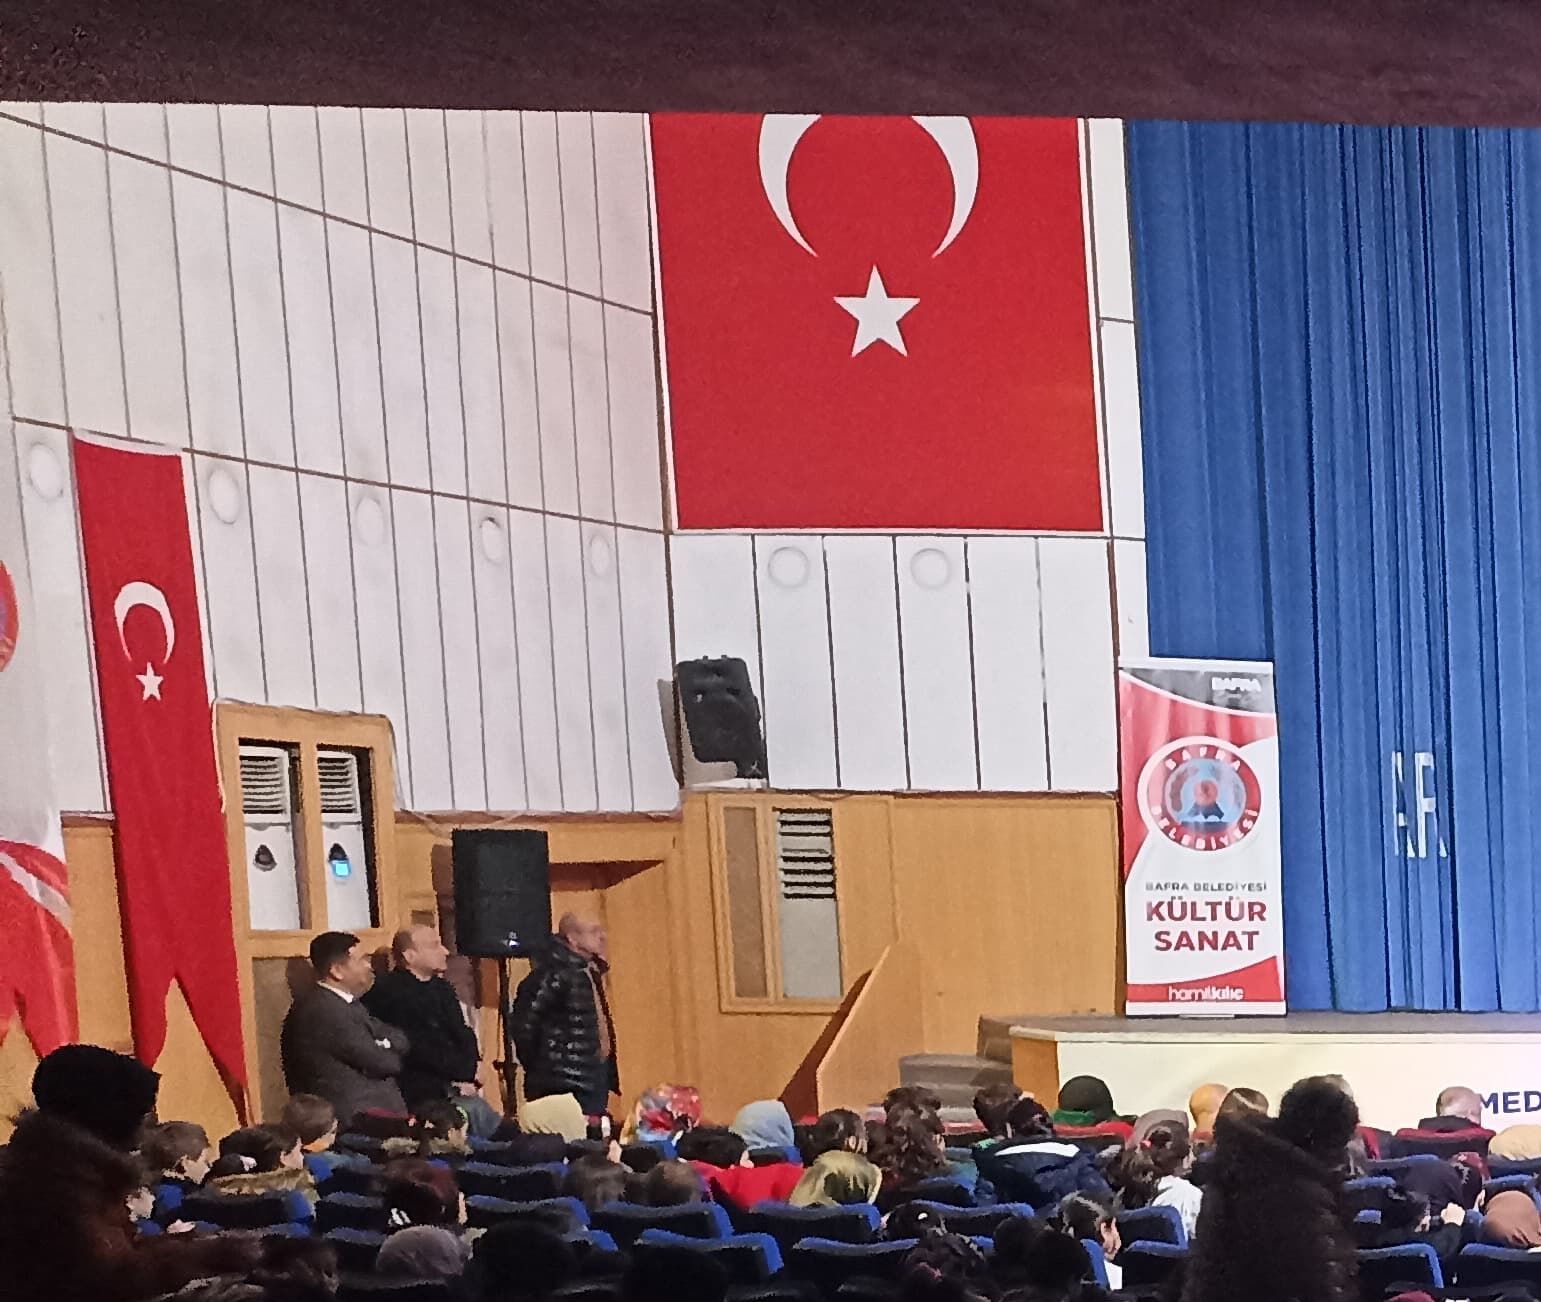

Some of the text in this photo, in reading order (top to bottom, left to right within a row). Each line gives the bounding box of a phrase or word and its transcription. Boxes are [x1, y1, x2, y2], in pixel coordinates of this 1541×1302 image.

[1164, 746, 1241, 771] BAFRA
[1145, 895, 1268, 922] KÜLTÜR
[1153, 930, 1260, 952] SANAT
